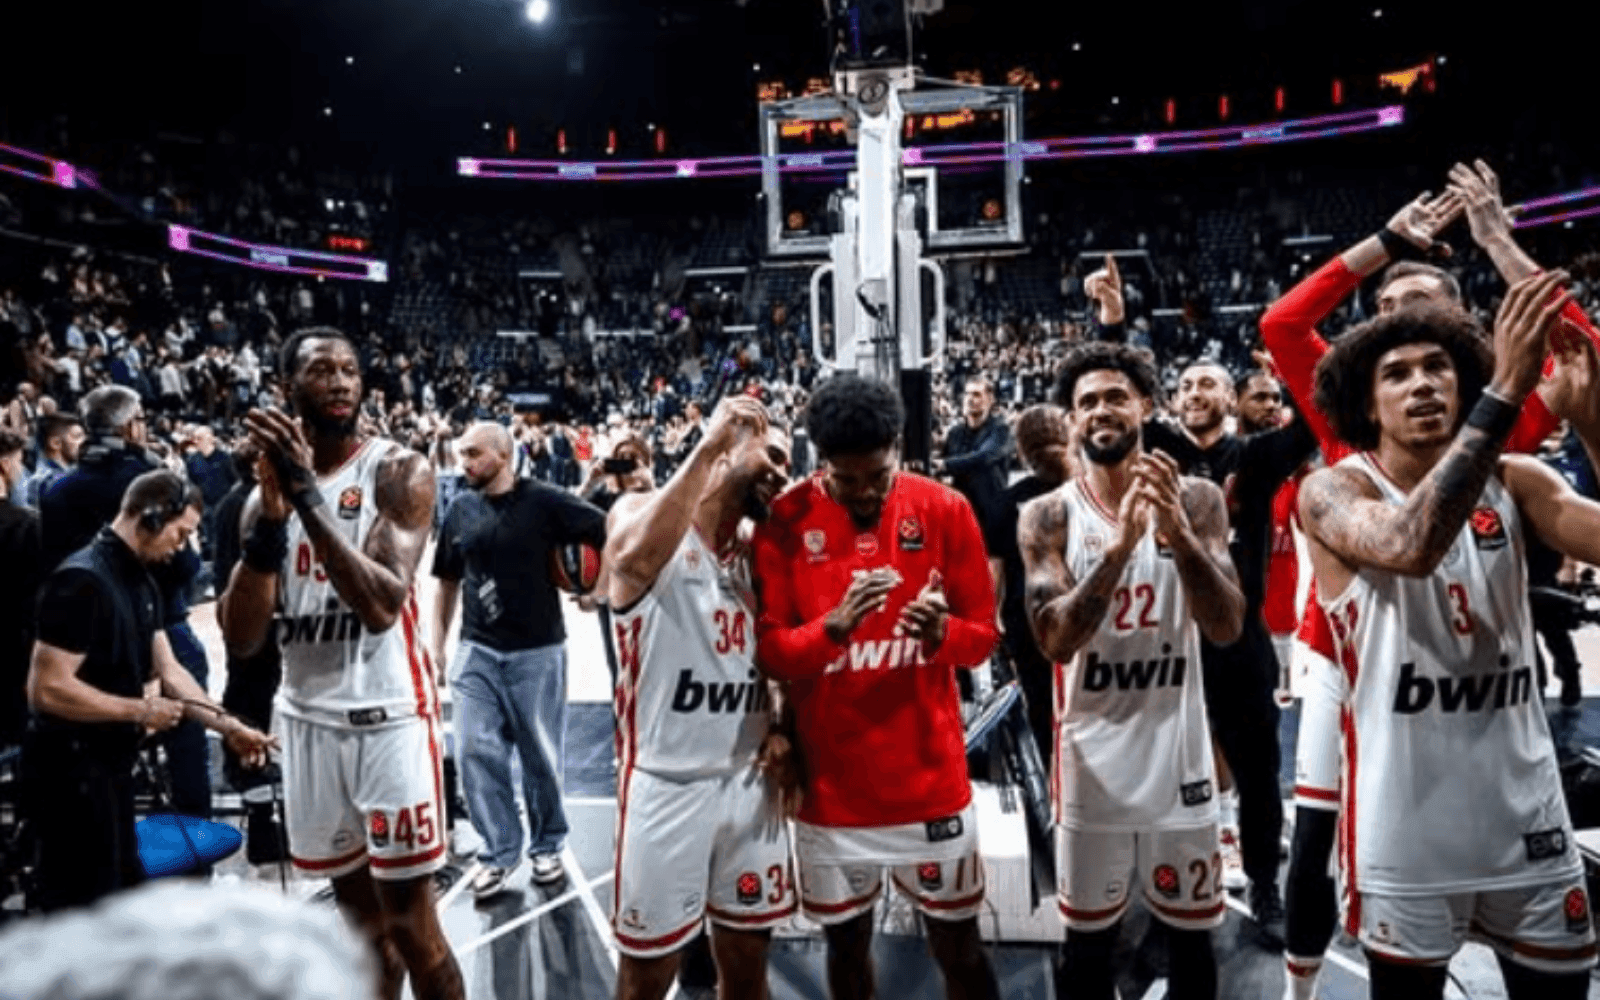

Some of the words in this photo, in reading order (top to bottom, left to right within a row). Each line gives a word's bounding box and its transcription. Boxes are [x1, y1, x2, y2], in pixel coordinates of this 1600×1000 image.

[1114, 584, 1159, 630] 22
[1449, 583, 1474, 634] 3
[714, 609, 746, 655] 34
[1392, 654, 1532, 714] bwin
[394, 802, 434, 850] 45
